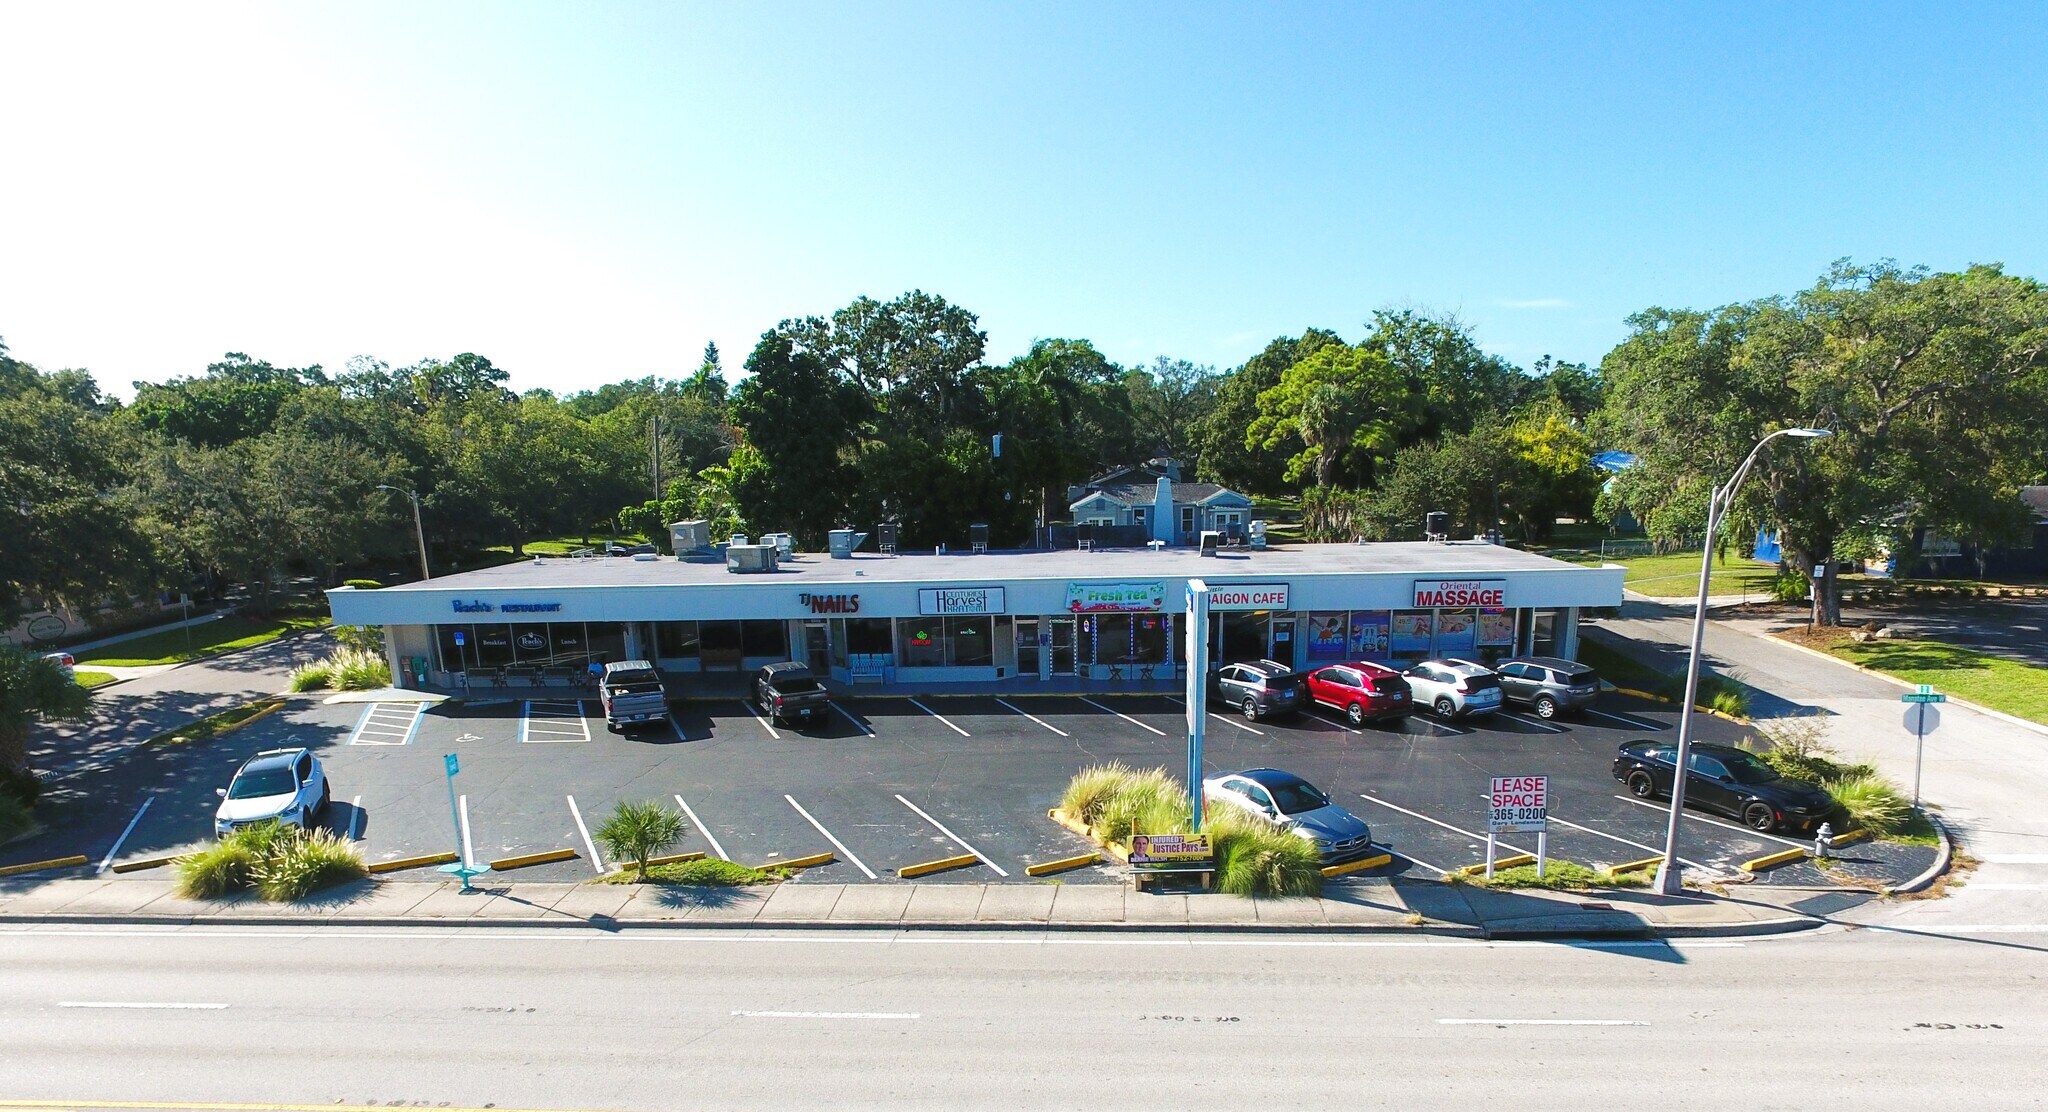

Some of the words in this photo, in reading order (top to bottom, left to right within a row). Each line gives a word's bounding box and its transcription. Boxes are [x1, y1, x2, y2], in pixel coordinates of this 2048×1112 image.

[1440, 581, 1481, 590] Oriental
[936, 590, 987, 612] Harvest
[1088, 590, 1123, 601] Fresh
[1126, 590, 1148, 600] Tea
[1209, 593, 1249, 605] AIGON
[1253, 592, 1285, 604] CAFE
[1416, 590, 1504, 606] MASSAGE
[501, 603, 562, 613] RESTAURANT
[798, 593, 811, 607] TJ
[811, 594, 859, 614] NAILS
[521, 637, 543, 646] Peach's
[1493, 778, 1545, 793] LEASE
[1491, 794, 1544, 808] SPACE
[1494, 808, 1546, 821] 365-0200
[1152, 844, 1180, 854] JUSTICE
[1181, 842, 1199, 853] PAYS
